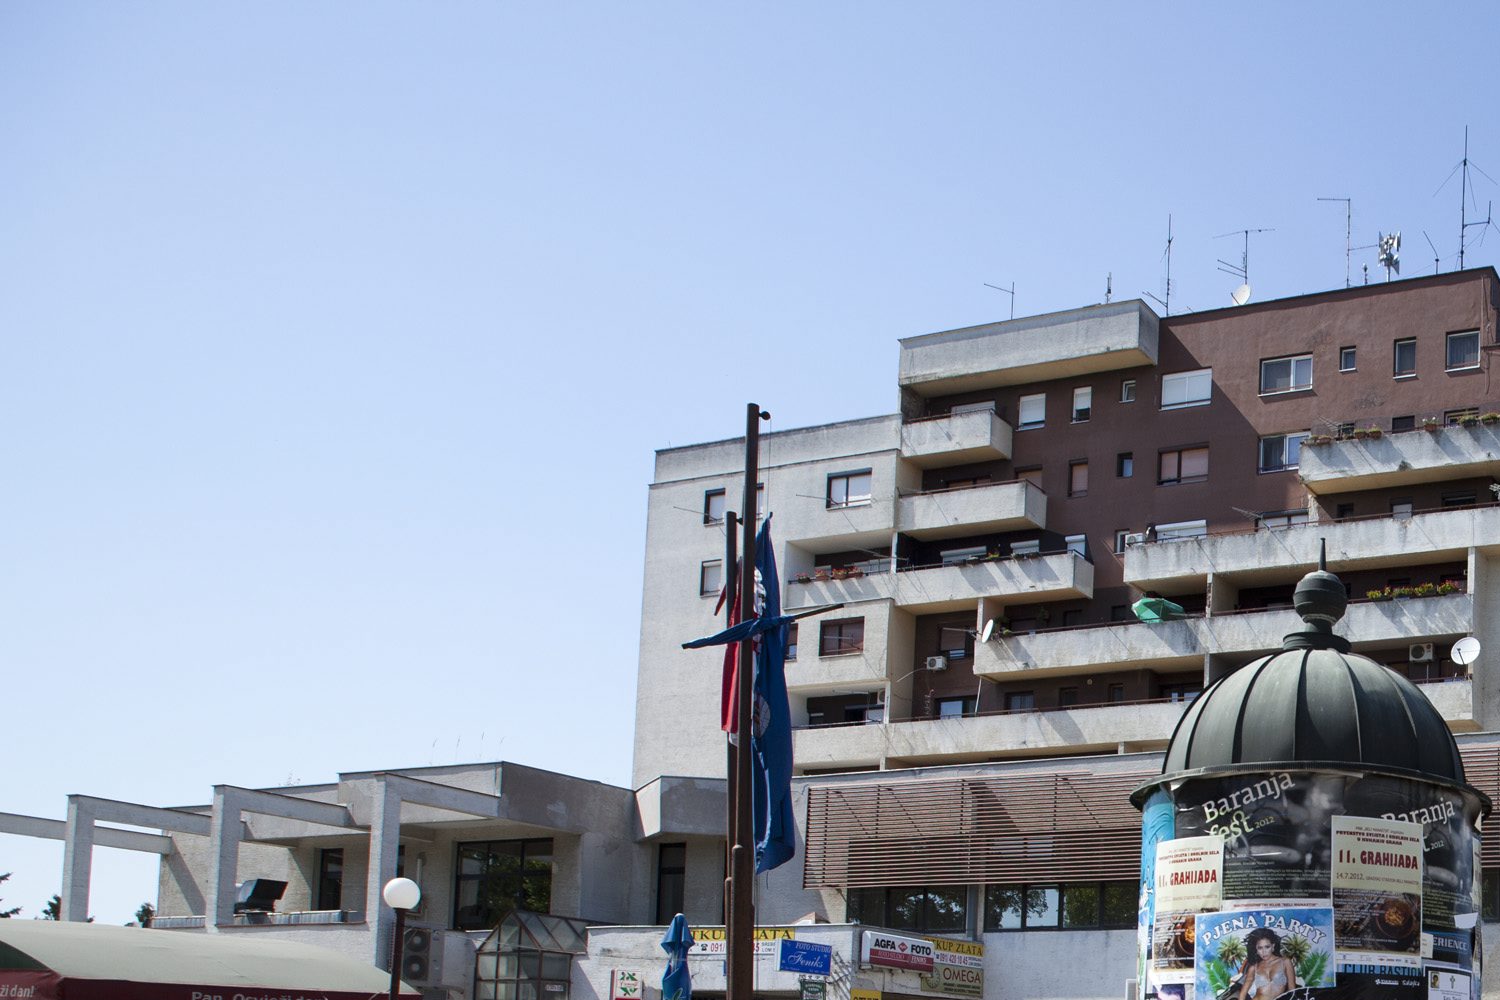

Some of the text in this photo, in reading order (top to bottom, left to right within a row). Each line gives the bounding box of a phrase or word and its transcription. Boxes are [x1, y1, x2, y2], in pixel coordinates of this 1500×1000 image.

[1202, 771, 1295, 823] Baranja
[1254, 816, 1275, 829] 2012
[1431, 840, 1445, 850] 2012
[1360, 850, 1418, 870] GRAHIJADA
[1170, 869, 1217, 887] GRAHIJADA
[691, 929, 793, 940] TKU ATA
[1202, 914, 1326, 946] PJENA PARTY
[796, 942, 831, 953] FOTO STUDIO
[874, 938, 931, 955] AGFA FOTO
[956, 943, 983, 956] ZLATA
[788, 951, 823, 967] Feniks
[943, 967, 981, 983] OMEGA
[10, 985, 34, 999] dan!
